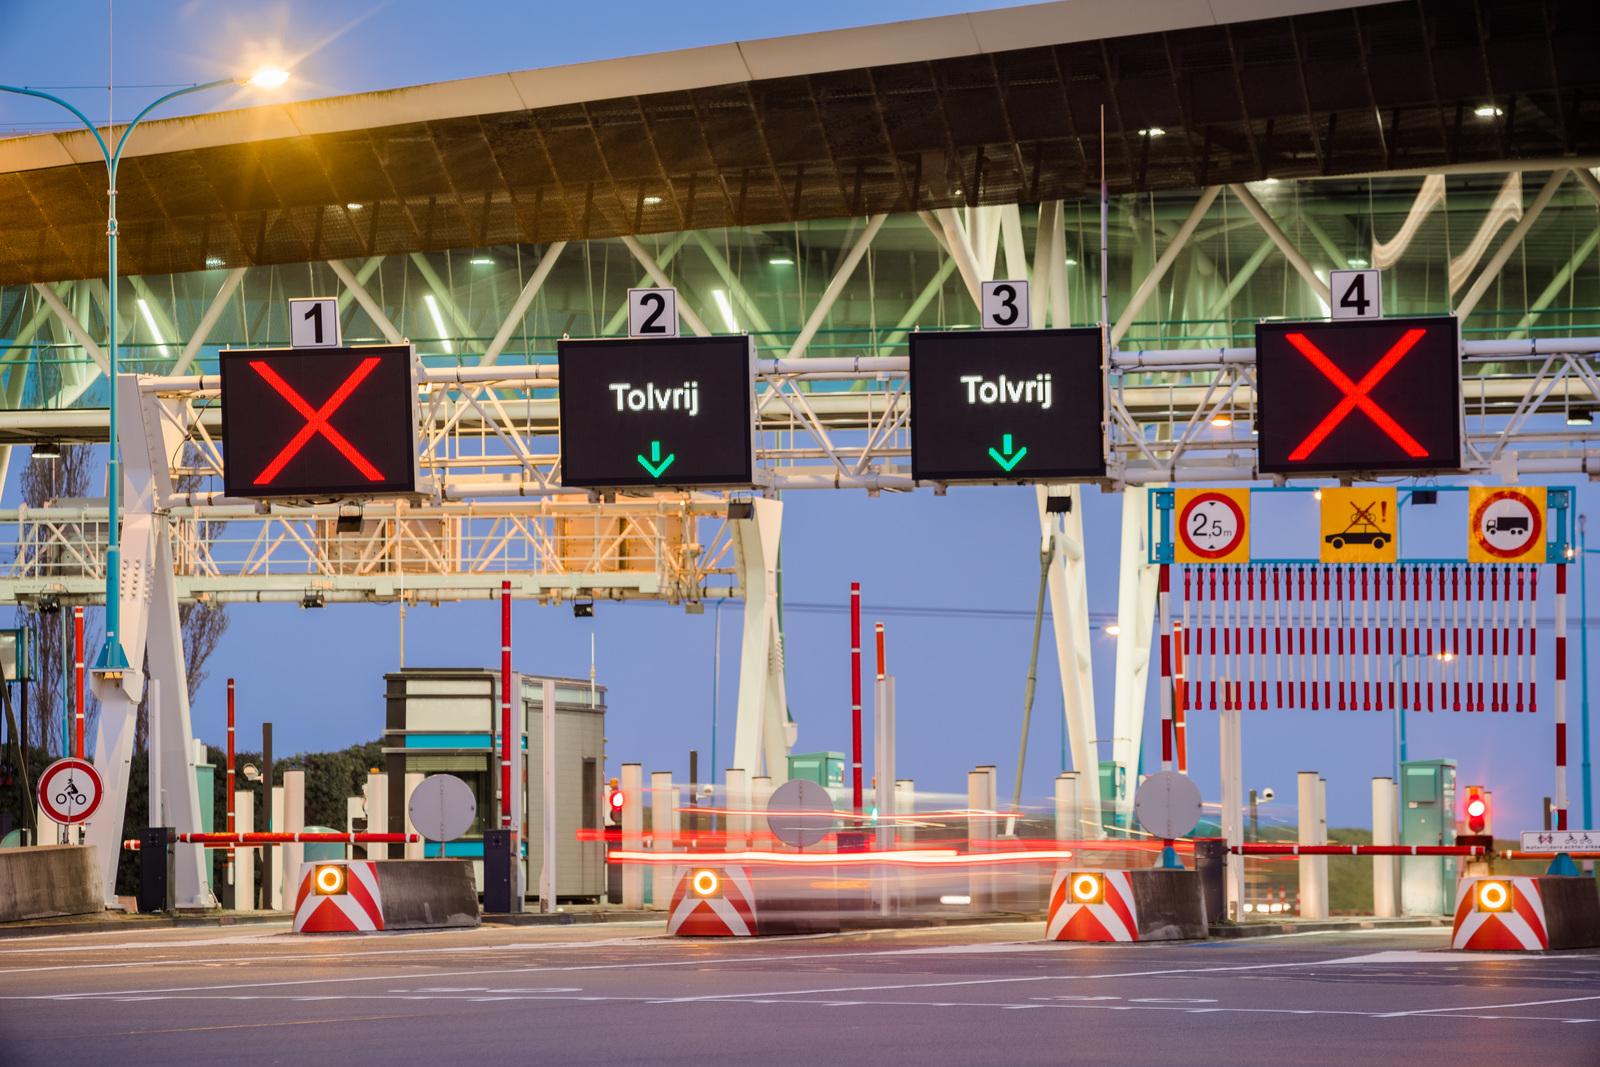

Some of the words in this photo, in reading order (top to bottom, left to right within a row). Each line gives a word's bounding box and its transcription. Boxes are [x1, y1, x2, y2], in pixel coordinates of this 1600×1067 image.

[639, 292, 667, 334] 2
[992, 283, 1019, 327] 3
[1339, 273, 1371, 316] 4
[304, 302, 324, 344] 1
[608, 381, 699, 417] Tolvrij
[960, 373, 1052, 410] Tolvrij
